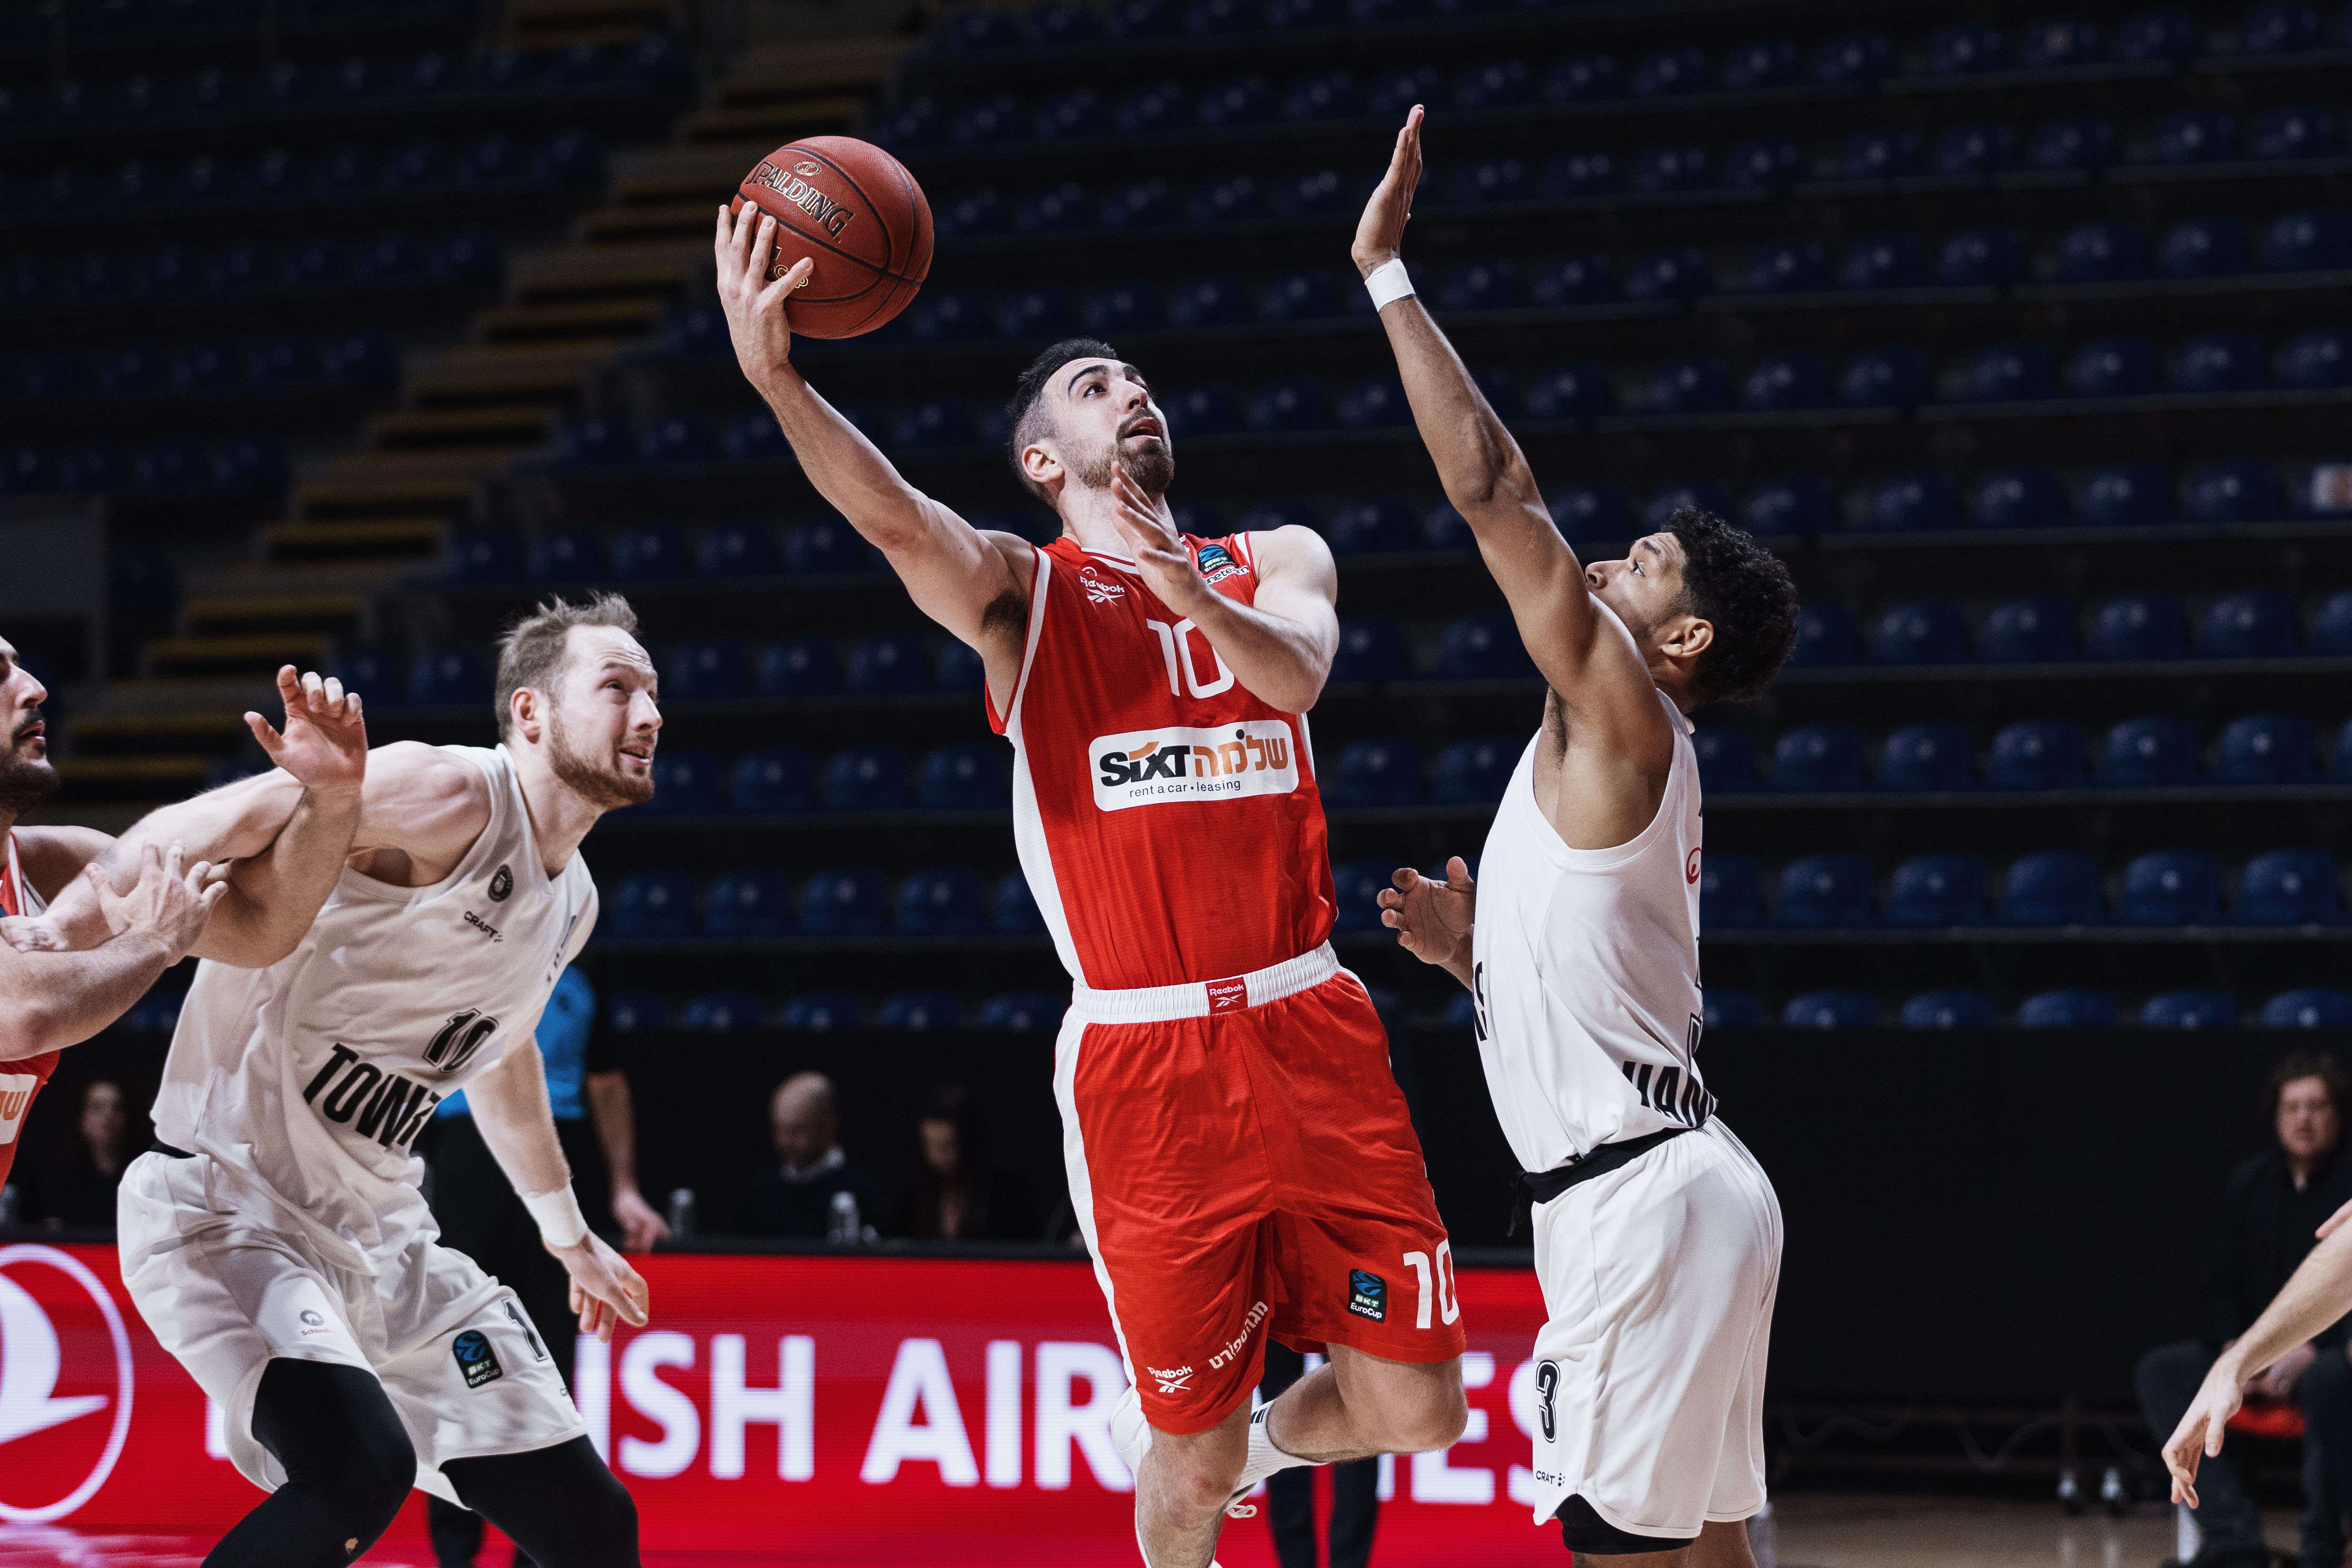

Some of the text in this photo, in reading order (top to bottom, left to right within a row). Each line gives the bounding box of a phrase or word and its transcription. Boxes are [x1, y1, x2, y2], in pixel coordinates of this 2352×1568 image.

[745, 161, 854, 238] SPALDING
[1079, 575, 1125, 593] Reebok
[1146, 618, 1235, 699] 10
[1129, 786, 1154, 797] rent
[1168, 783, 1187, 793] car
[1197, 781, 1241, 792] leasing
[463, 911, 498, 938] CRAFT
[1209, 984, 1244, 996] Reebok
[423, 1007, 499, 1073] 10
[1403, 1238, 1459, 1329] 10
[1355, 1294, 1379, 1308] BKT
[1350, 1302, 1382, 1319] EuroCup
[301, 1328, 336, 1336] Schind
[501, 1297, 548, 1362] 1
[468, 1368, 500, 1386] EuroCup
[1147, 1365, 1193, 1379] Reebok
[1536, 1359, 1561, 1443] 3
